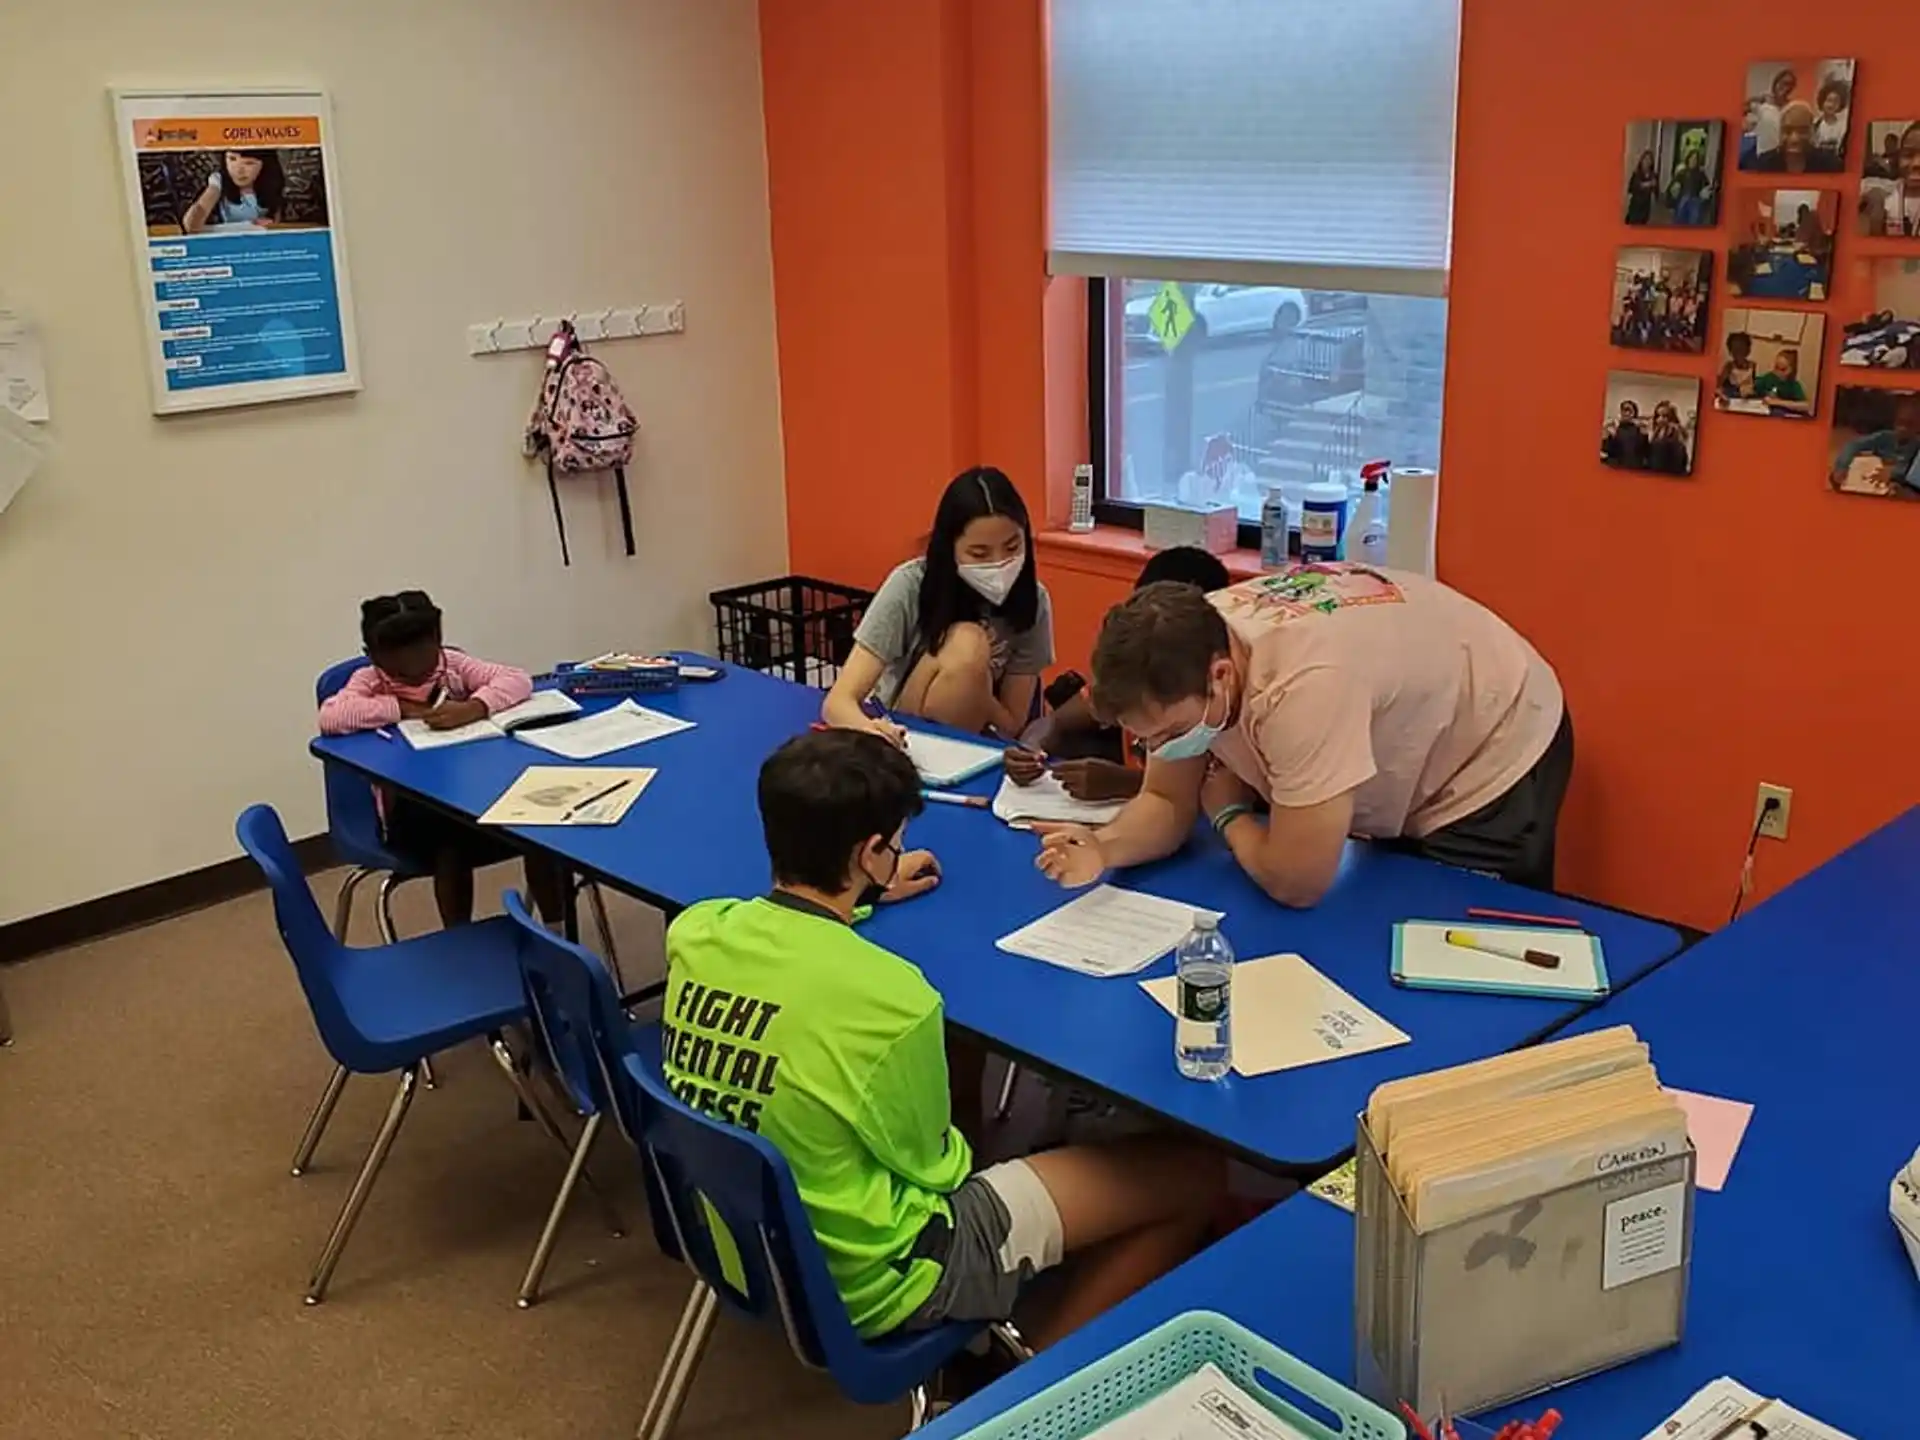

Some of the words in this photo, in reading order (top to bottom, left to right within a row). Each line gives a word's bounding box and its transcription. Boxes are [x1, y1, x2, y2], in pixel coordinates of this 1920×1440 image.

[256, 125, 301, 139] VALUES
[675, 980, 782, 1041] FIGHT
[662, 1024, 780, 1095] MENTAL
[1597, 1142, 1666, 1171] CAMERON
[1620, 1206, 1668, 1233] peace.
